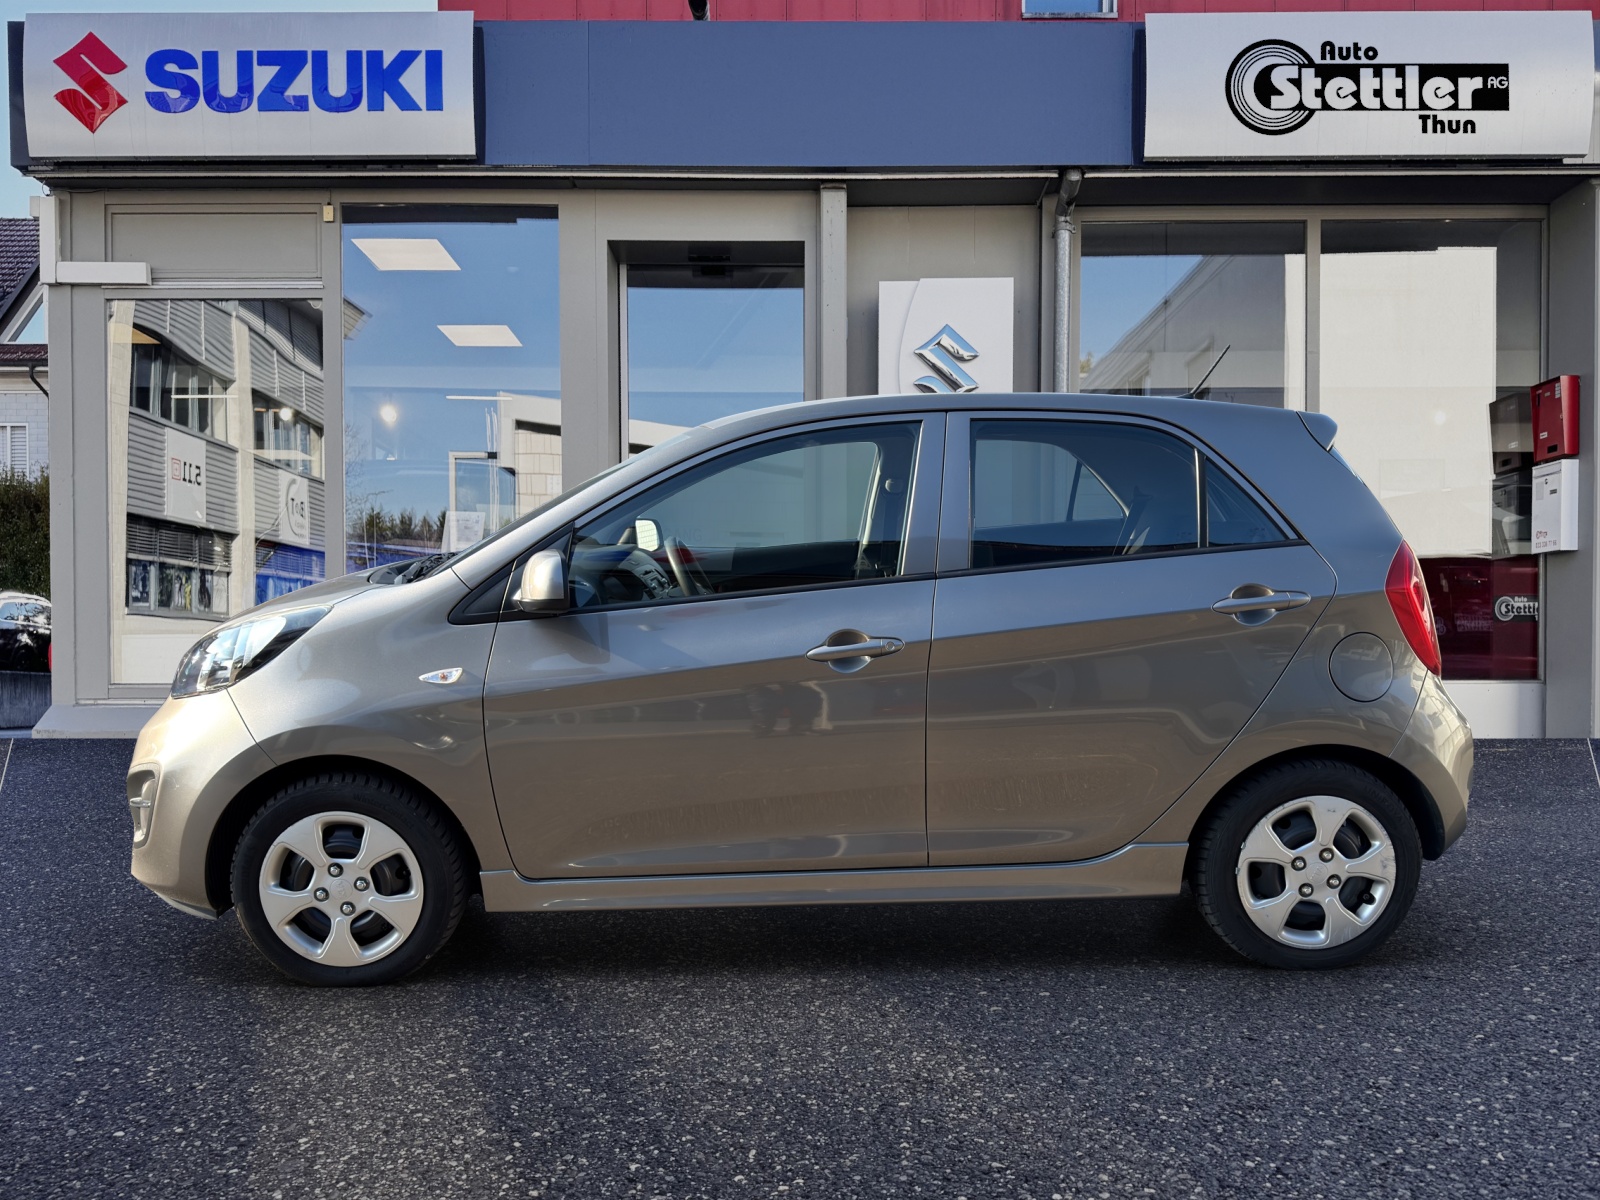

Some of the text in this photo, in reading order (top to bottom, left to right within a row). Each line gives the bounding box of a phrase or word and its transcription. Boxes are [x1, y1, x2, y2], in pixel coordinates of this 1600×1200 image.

[1320, 41, 1379, 61] Auto
[145, 49, 444, 113] SUZUKI
[1270, 64, 1509, 110] Stettler AG
[1418, 114, 1477, 134] Thun
[1504, 603, 1538, 614] Stettl
